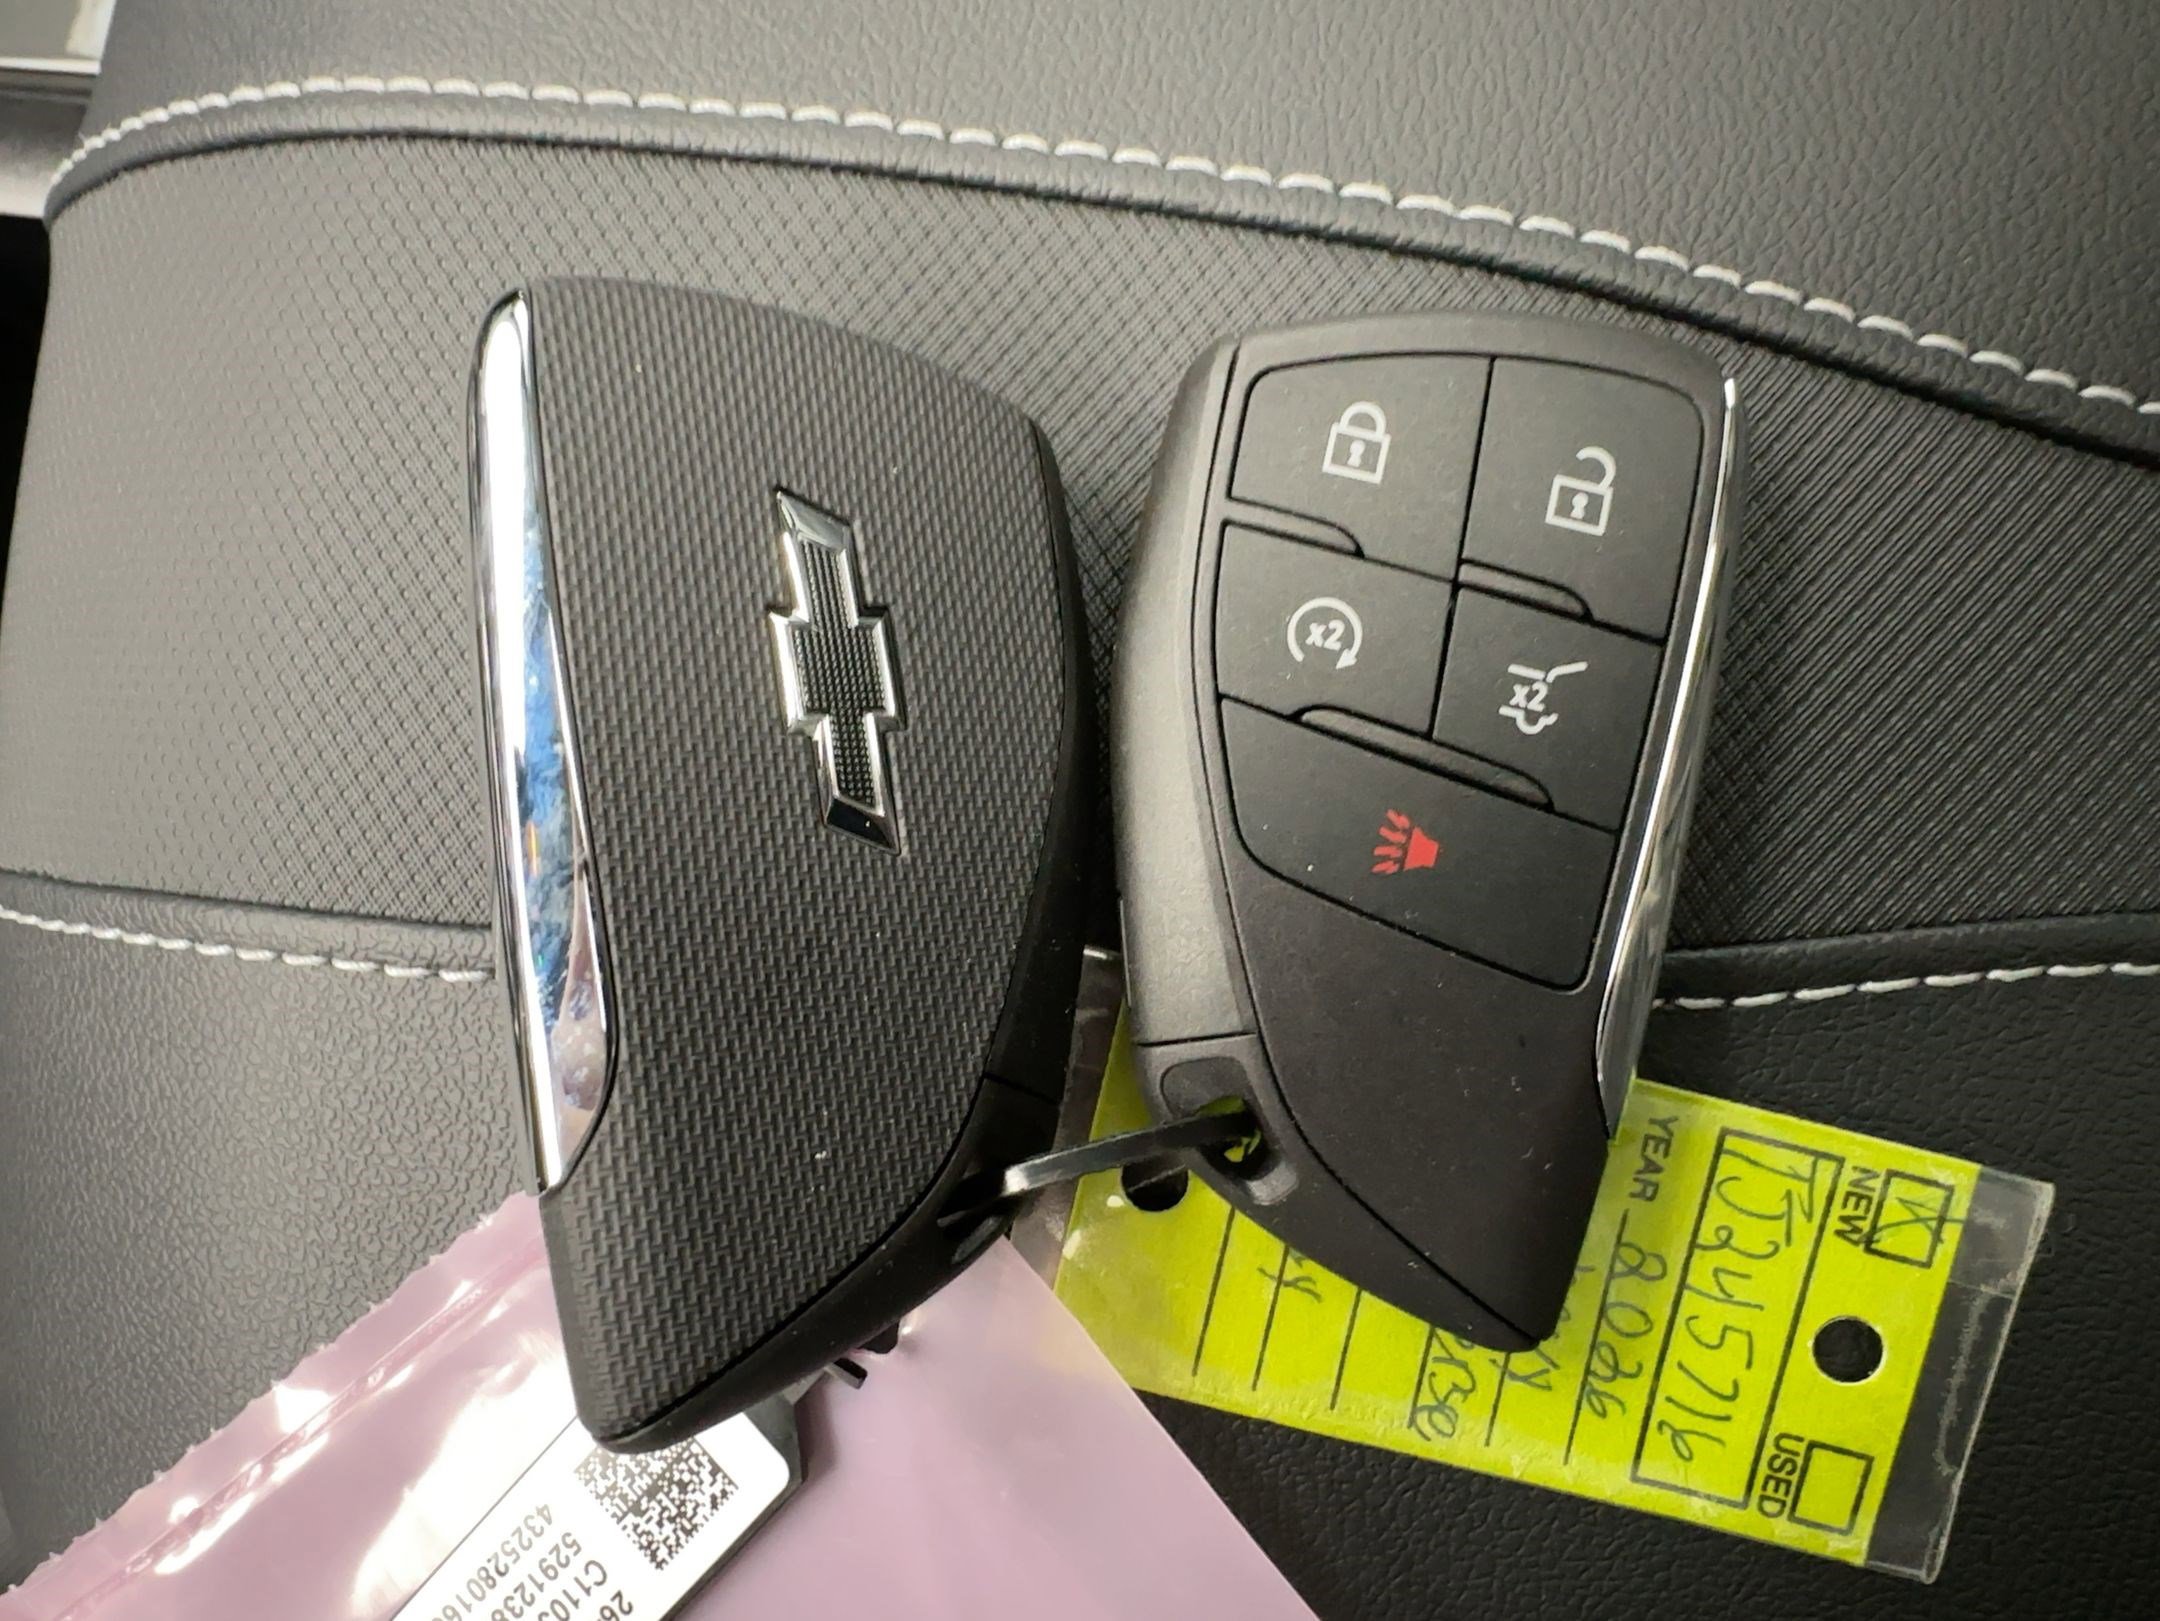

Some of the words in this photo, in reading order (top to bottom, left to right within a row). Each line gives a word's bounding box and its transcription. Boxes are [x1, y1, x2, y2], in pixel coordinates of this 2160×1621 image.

[1304, 618, 1346, 651] x2
[1628, 1115, 1680, 1202] YEAR
[1834, 1166, 1881, 1247] NEW
[1584, 1240, 1669, 1419] 2026
[1757, 1432, 1805, 1520] USED
[431, 1503, 553, 1621] 432528016
